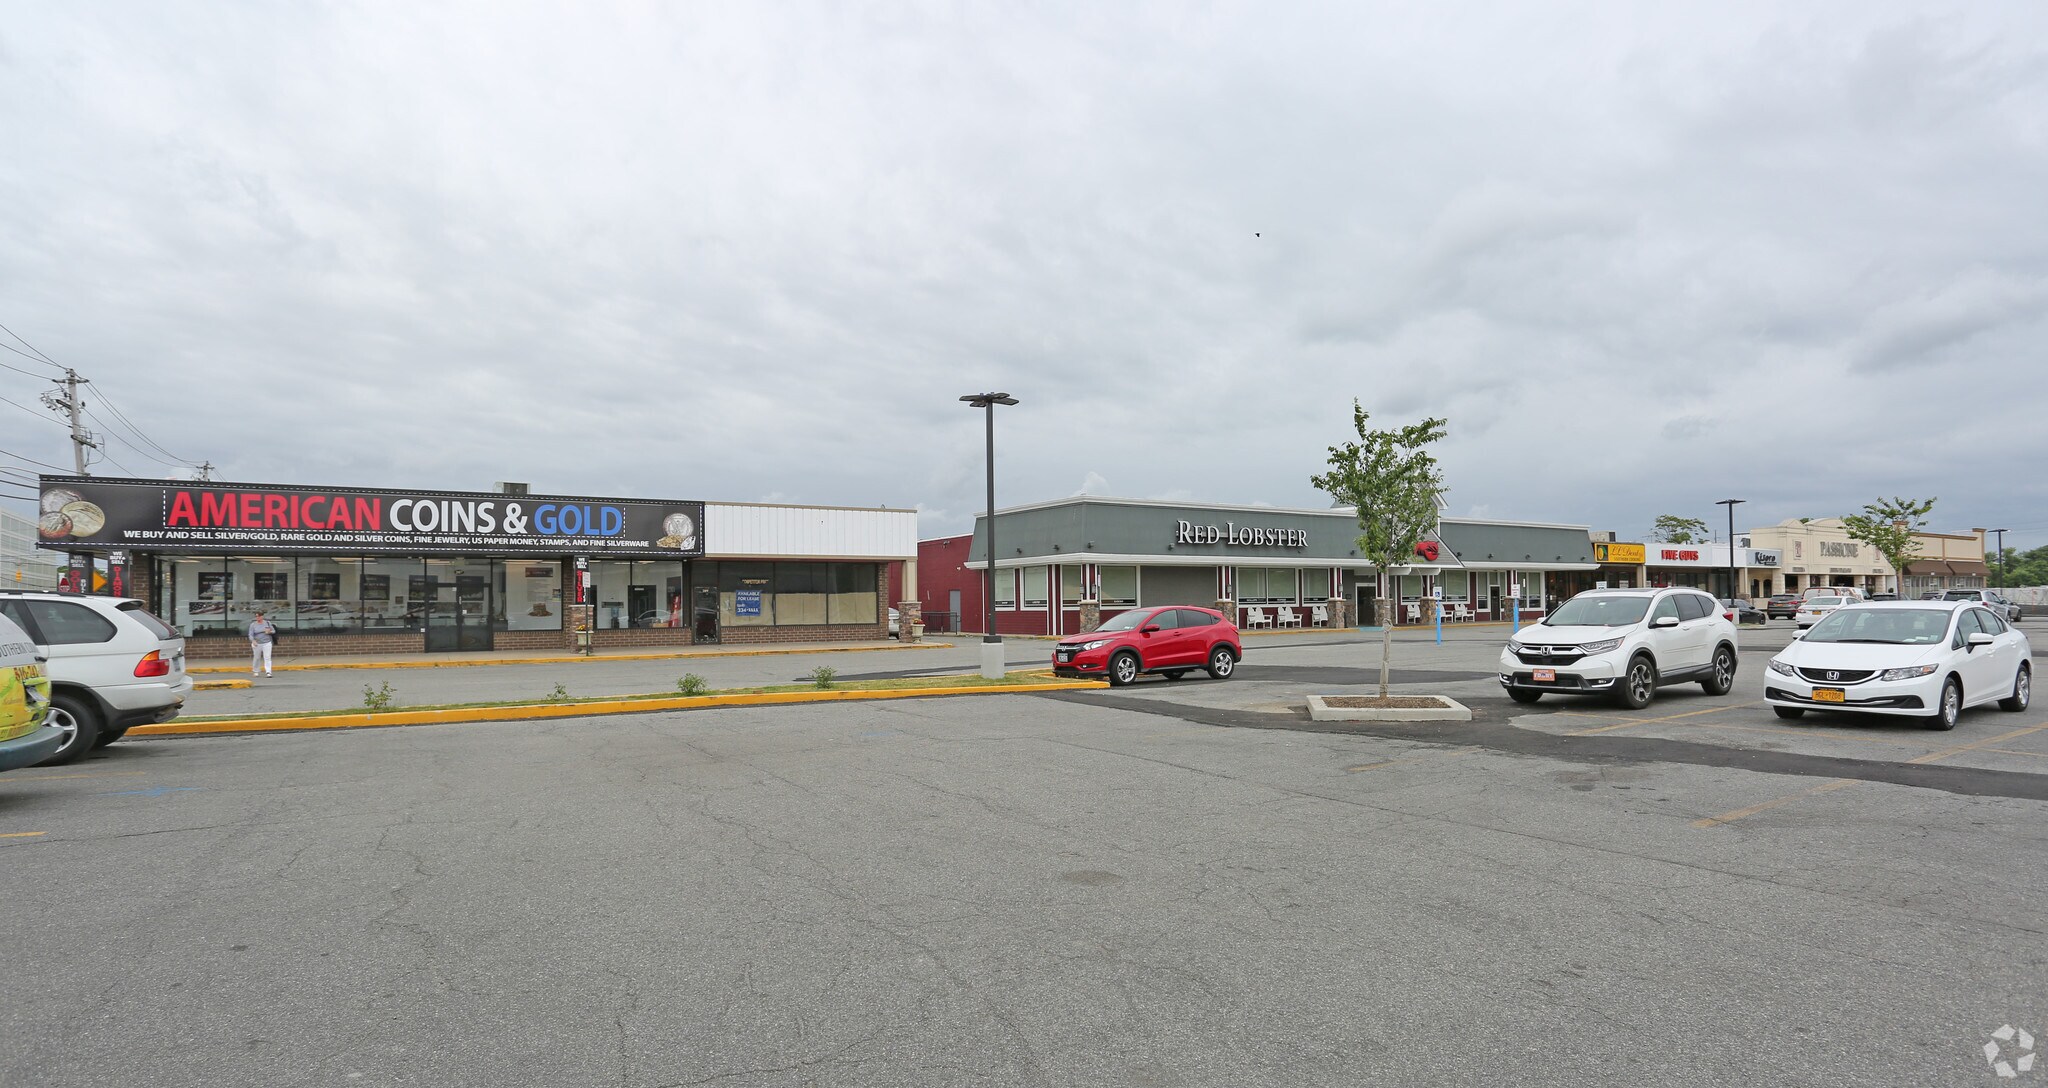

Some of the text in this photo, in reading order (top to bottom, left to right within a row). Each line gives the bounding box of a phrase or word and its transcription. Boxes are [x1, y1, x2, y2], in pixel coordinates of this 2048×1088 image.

[168, 491, 623, 537] AMERICAN COINS & GOLD
[166, 531, 189, 539] AND
[190, 532, 214, 540] SELL
[215, 532, 279, 542] SILVER/GOLD,
[306, 534, 332, 542] GOLD
[355, 534, 383, 543] SILVER
[384, 535, 413, 544] COINS,
[433, 536, 471, 544] JEWELRY,
[484, 537, 508, 546] PAPER
[510, 538, 539, 547] MONEY,
[540, 538, 572, 547] STAMPS,
[606, 540, 650, 548] SILVERWARE
[1178, 520, 1308, 547] RED LOBSTER
[1661, 550, 1699, 561] FIVE GUYS
